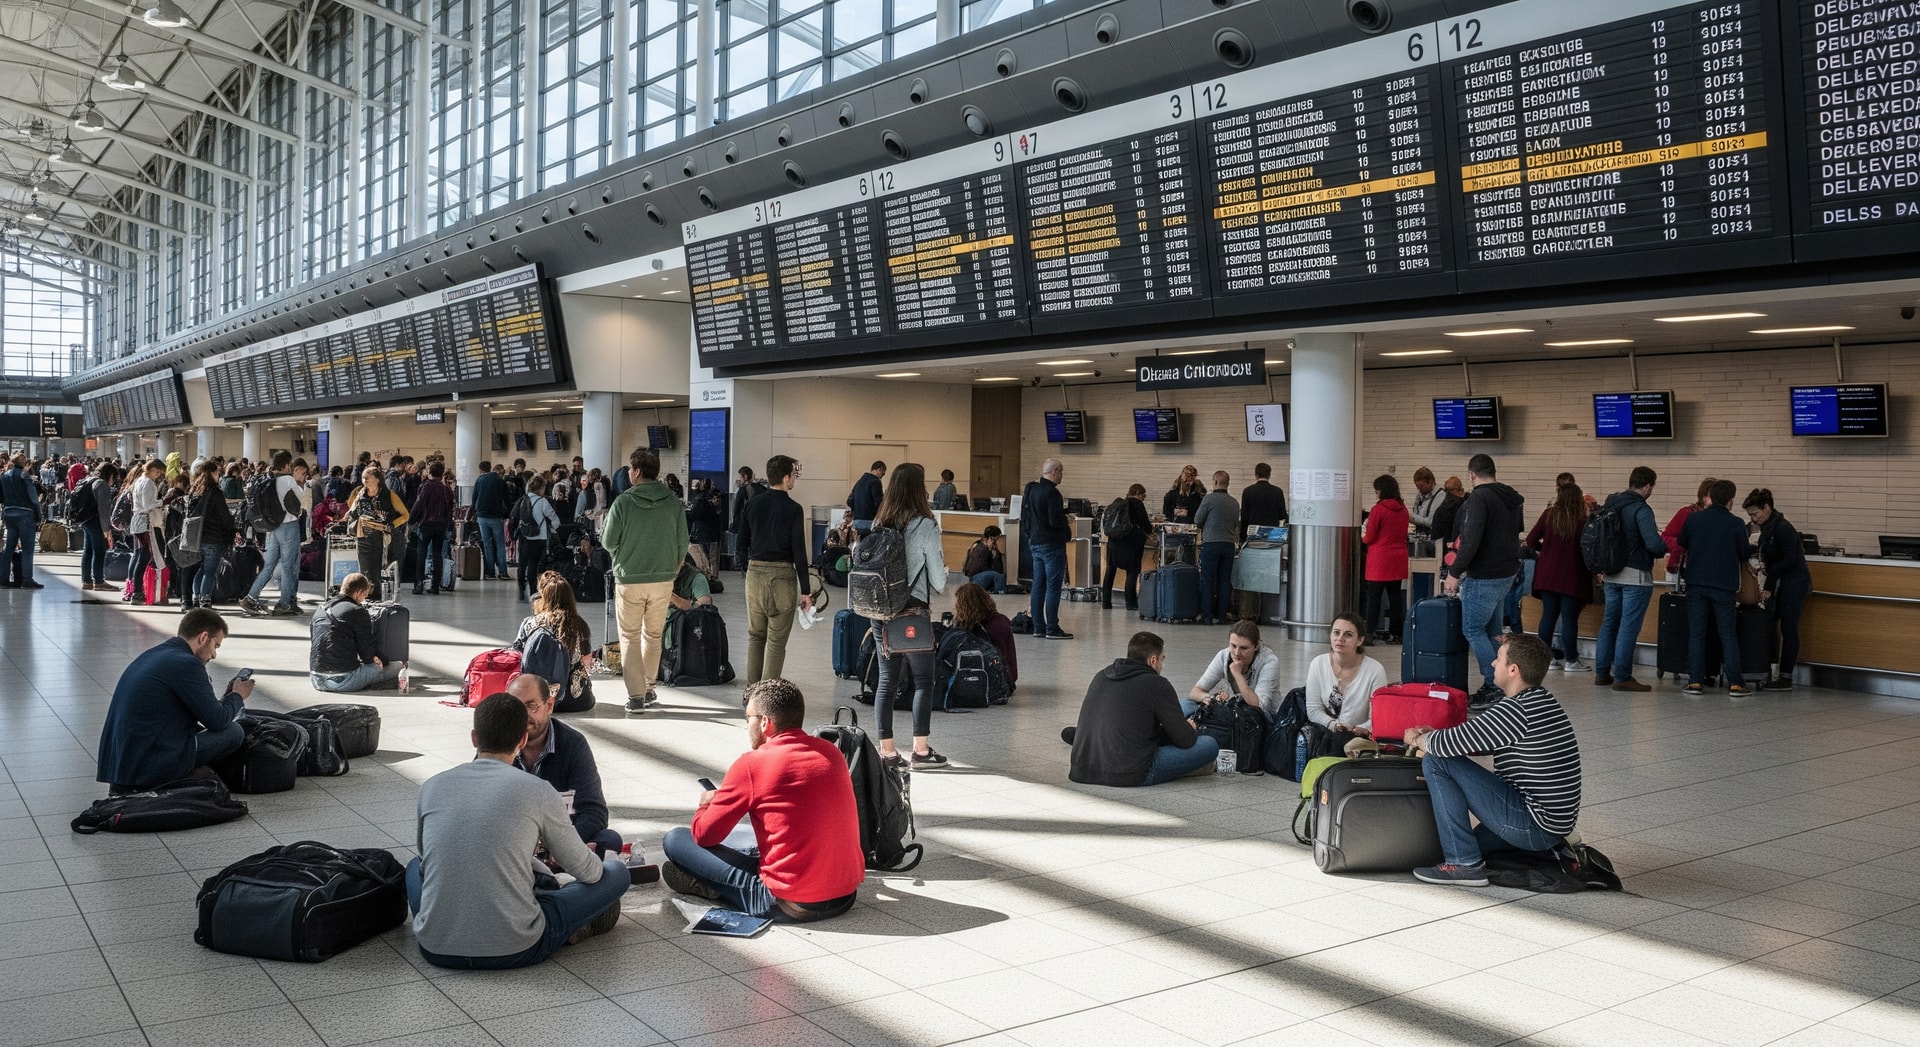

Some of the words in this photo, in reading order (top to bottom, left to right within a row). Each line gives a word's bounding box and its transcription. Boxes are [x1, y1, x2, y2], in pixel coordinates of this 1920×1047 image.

[1448, 18, 1483, 52] 12
[1651, 20, 1665, 33] 12
[1407, 32, 1424, 62] 6
[1817, 41, 1915, 71] DELEAYED
[1169, 94, 1182, 119] 3
[1202, 83, 1228, 111] 12
[993, 141, 1004, 162] 9
[1130, 140, 1139, 149] 10
[859, 178, 868, 196] 6
[878, 171, 895, 191] 12
[1136, 199, 1145, 208] 10
[754, 206, 761, 222] 3
[1823, 205, 1882, 224] DELSS
